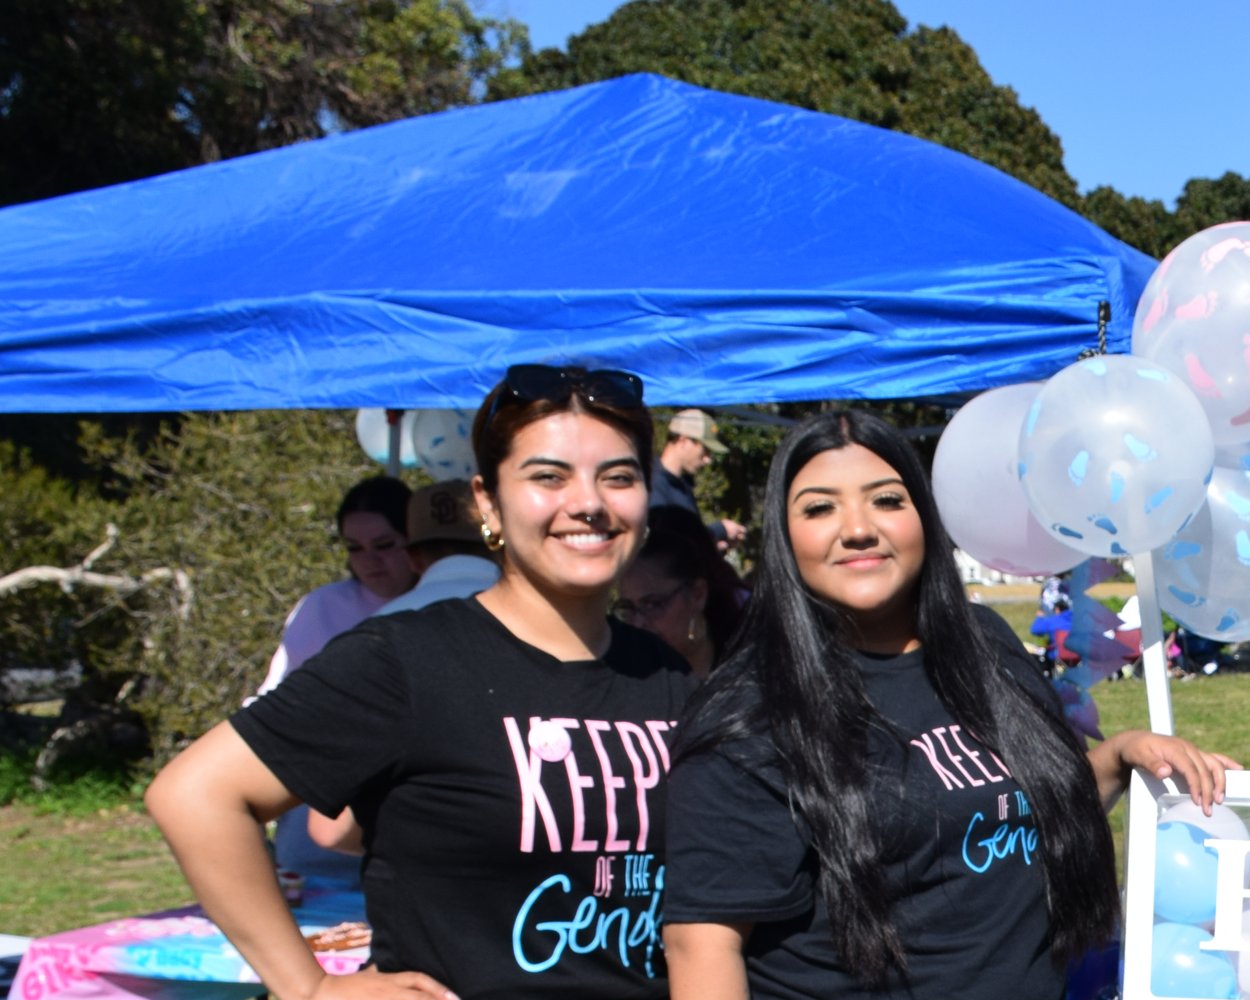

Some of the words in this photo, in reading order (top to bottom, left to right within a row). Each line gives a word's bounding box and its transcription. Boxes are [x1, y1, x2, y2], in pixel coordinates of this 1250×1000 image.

[910, 724, 1012, 790] KEE
[593, 855, 616, 898] OF
[624, 854, 654, 896] THE
